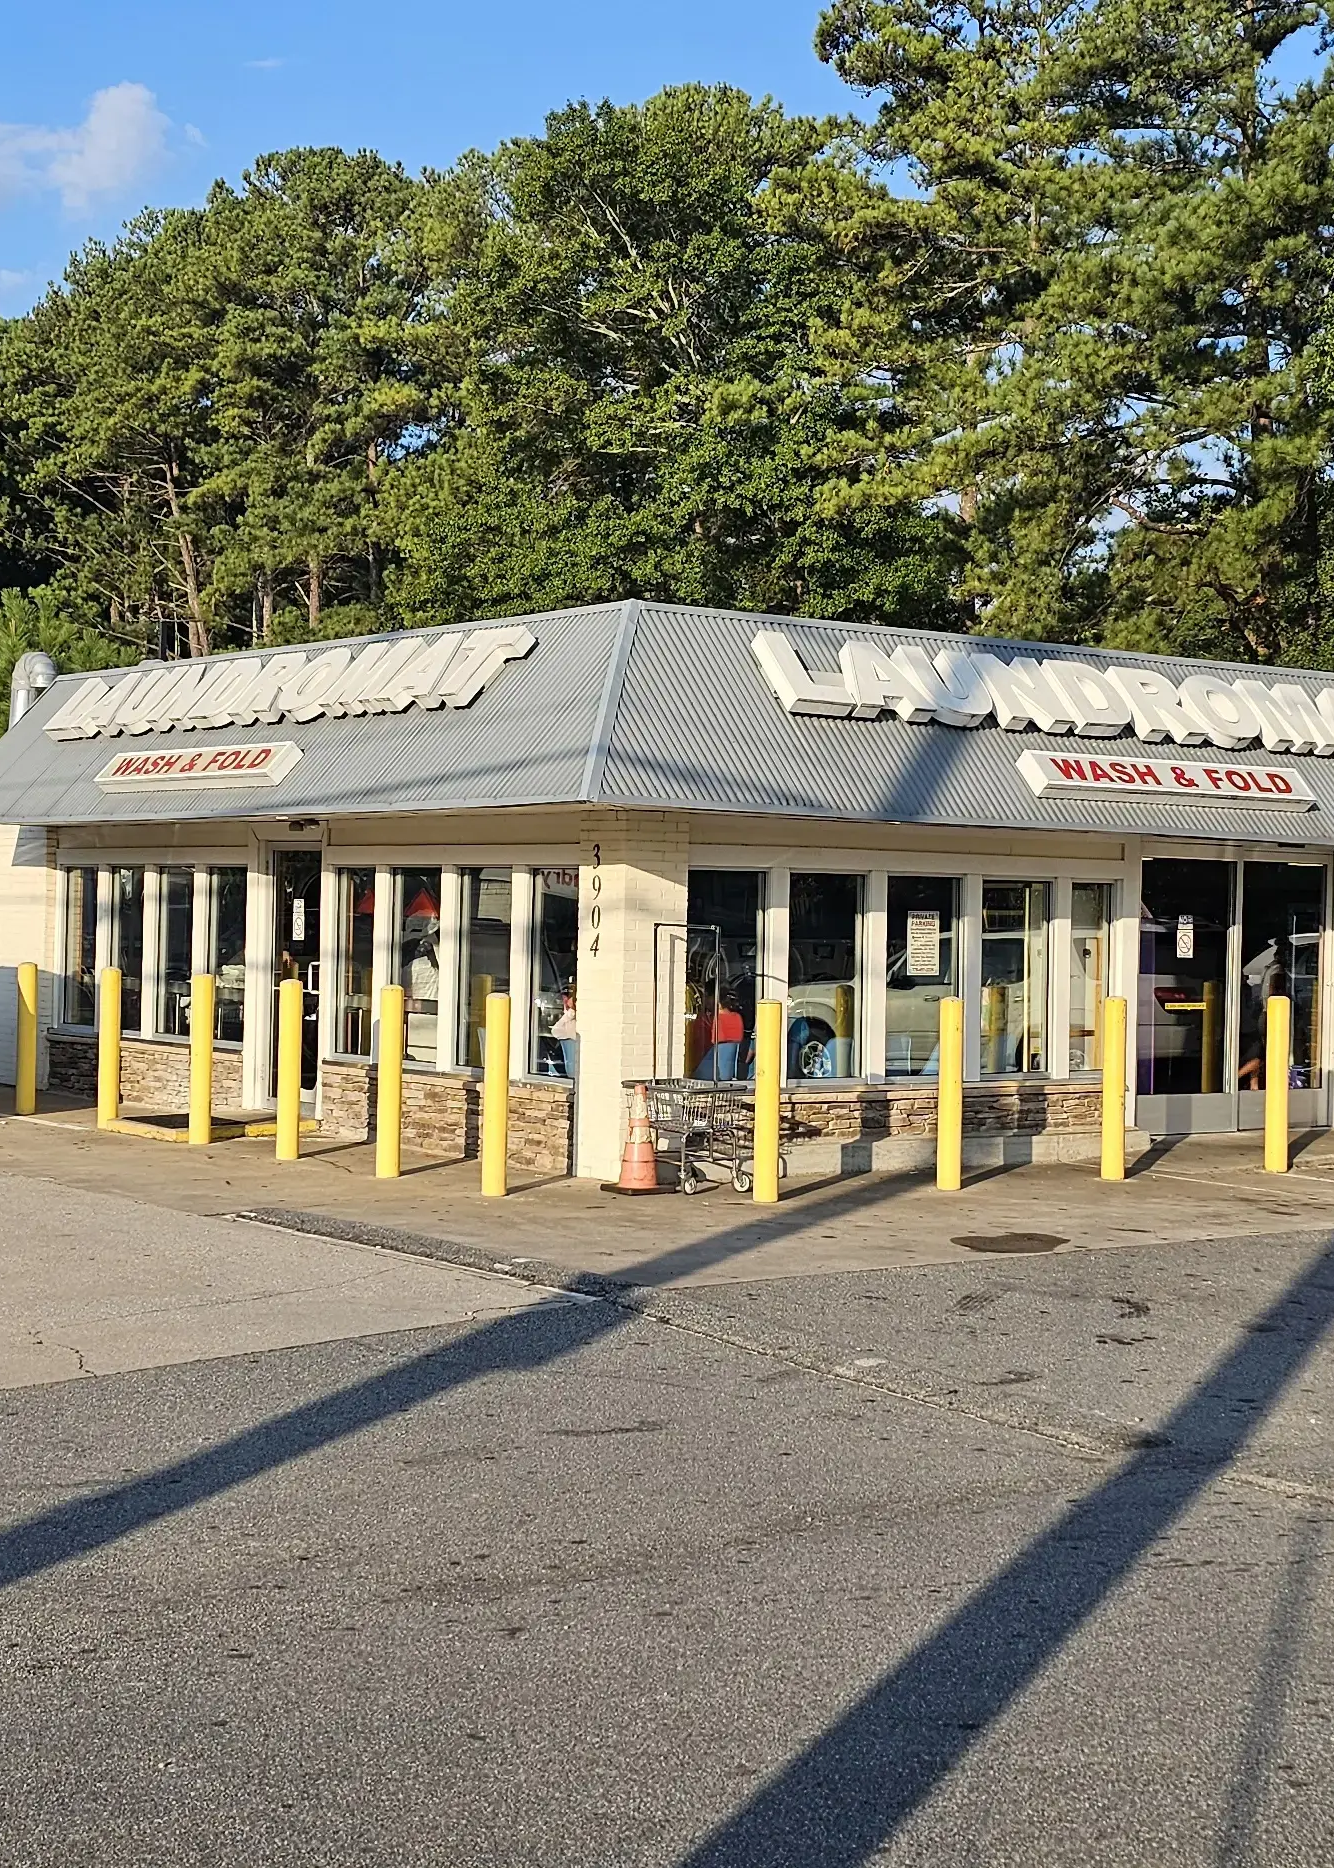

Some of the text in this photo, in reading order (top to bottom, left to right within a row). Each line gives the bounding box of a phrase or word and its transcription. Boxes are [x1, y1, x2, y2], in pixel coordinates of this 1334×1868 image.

[43, 626, 537, 742] LAUNDROMAT
[111, 748, 272, 777] WASH & FOLD
[1049, 757, 1293, 796] WASH & FOLD
[589, 843, 602, 958] 3904
